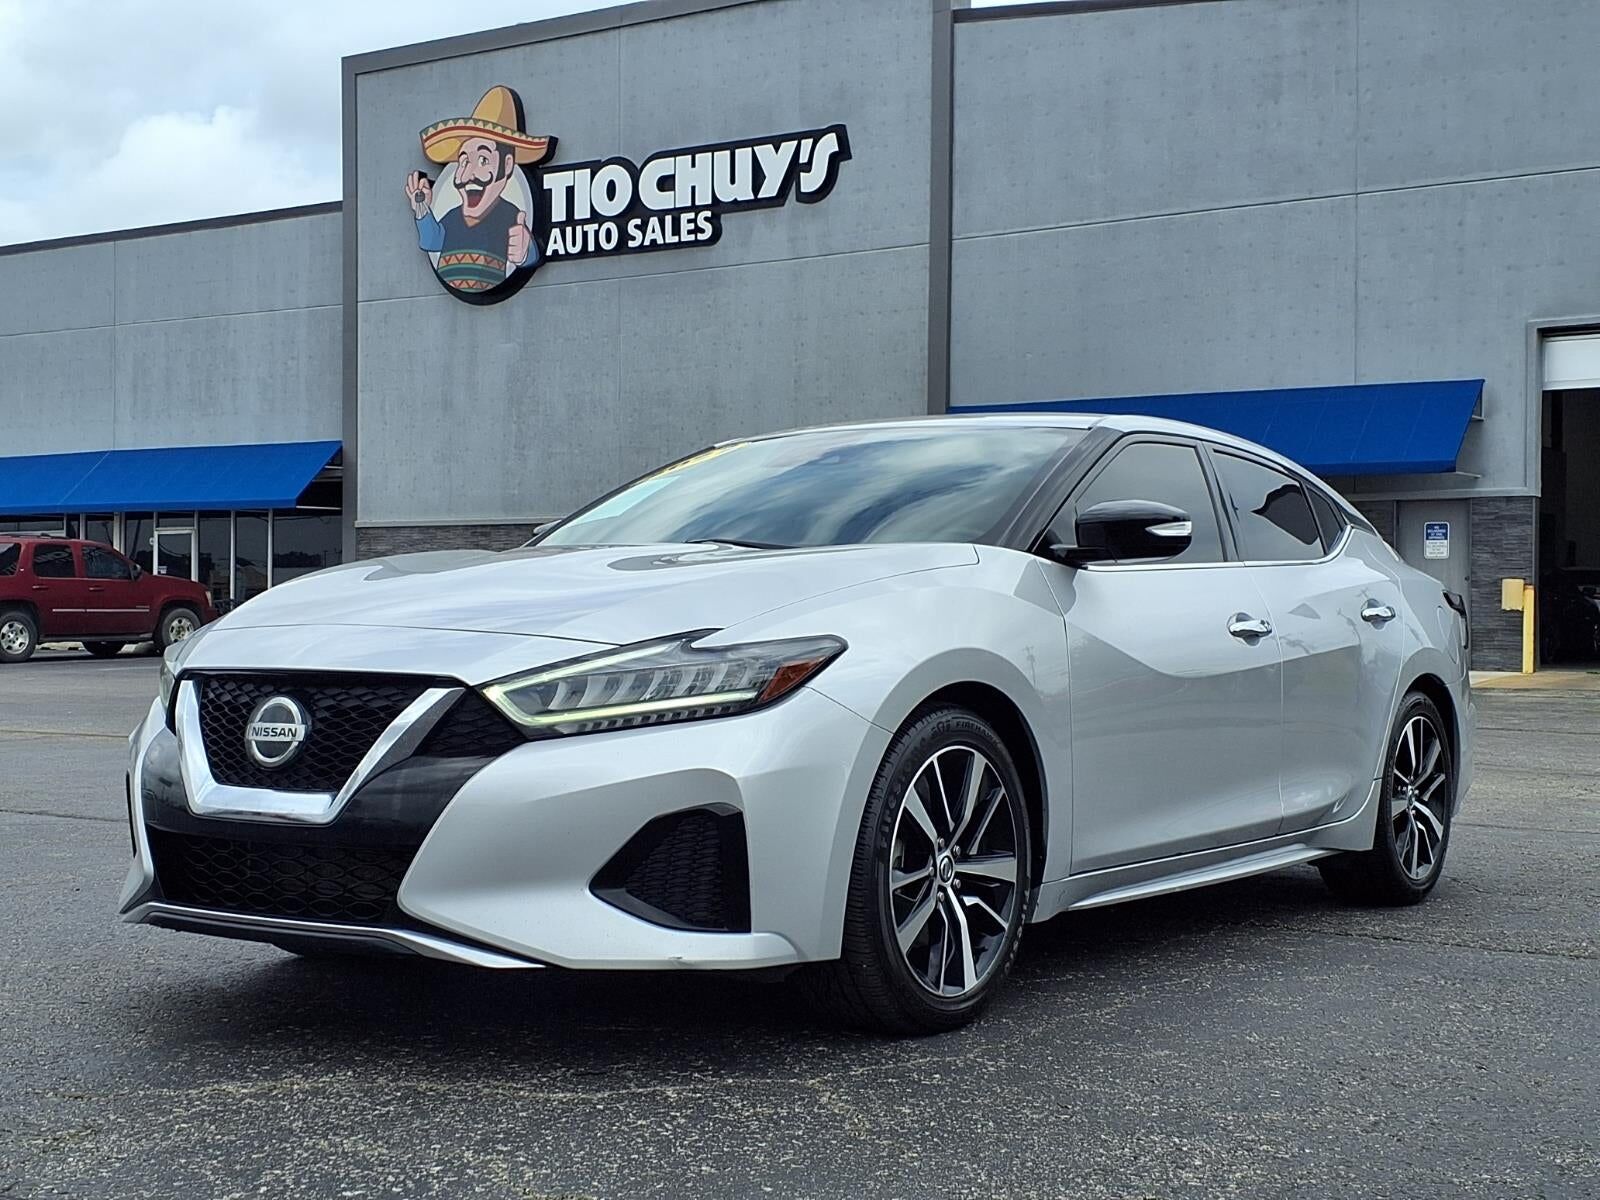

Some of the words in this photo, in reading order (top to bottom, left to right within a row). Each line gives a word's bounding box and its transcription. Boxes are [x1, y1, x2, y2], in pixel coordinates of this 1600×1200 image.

[542, 164, 633, 223] TIO
[638, 131, 839, 210] CHUY'S
[545, 221, 620, 256] AUTO
[627, 210, 714, 248] SALES
[251, 726, 298, 738] NISSAN
